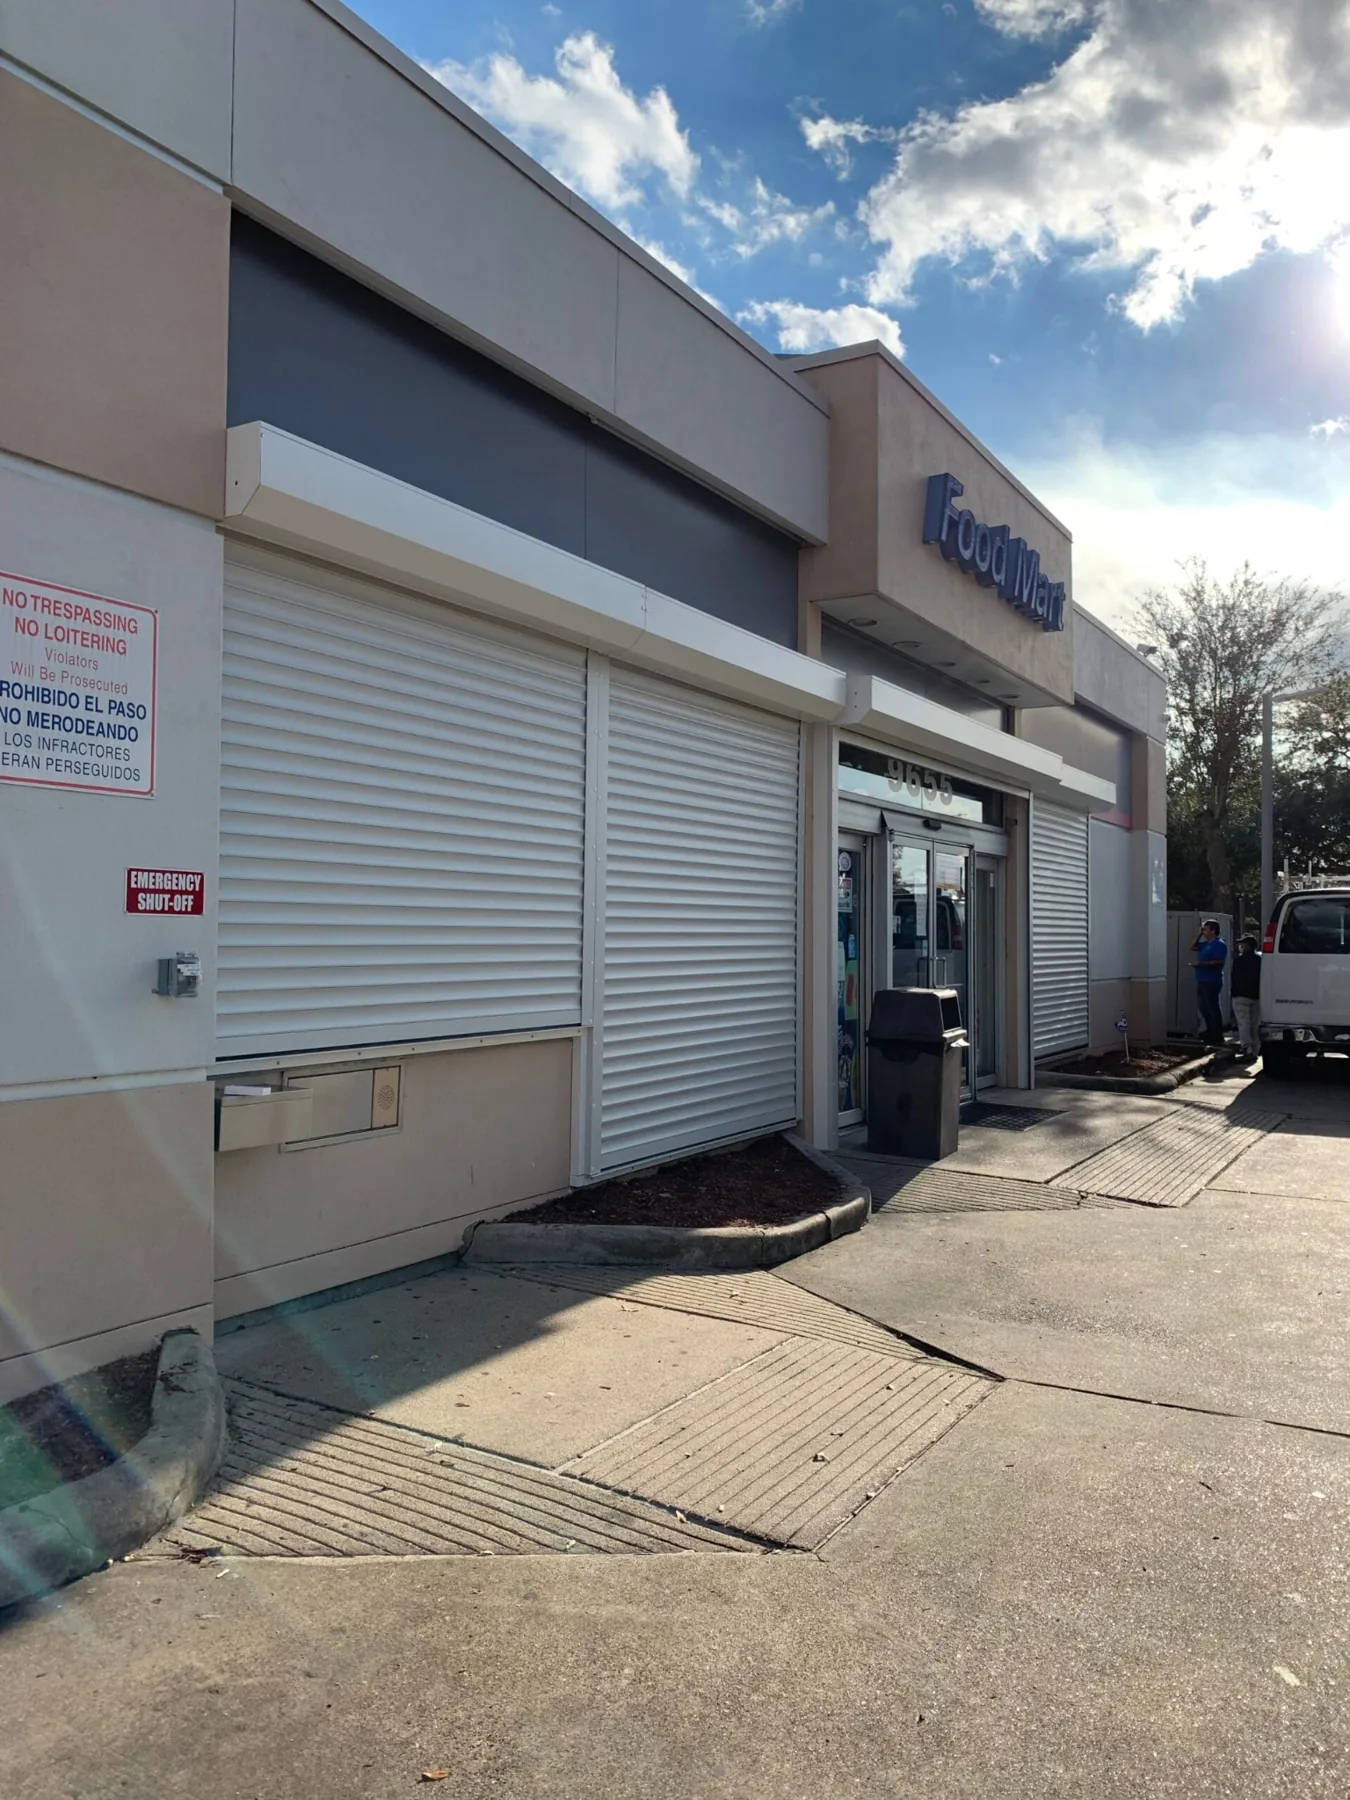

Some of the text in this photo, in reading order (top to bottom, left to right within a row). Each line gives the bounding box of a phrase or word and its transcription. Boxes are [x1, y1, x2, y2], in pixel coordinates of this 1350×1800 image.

[922, 473, 1066, 632] Food Mart
[2, 587, 138, 634] NO TRESPASSING
[14, 616, 127, 656] NO LOITERING
[44, 647, 99, 671] Violators
[11, 661, 128, 695] Will Be Prosecuted
[0, 680, 147, 720] ROHIBIDO EL PASO
[0, 706, 139, 742] NO MERODEANDO
[4, 731, 131, 762] LOS INFRACTORES
[1, 751, 141, 782] ERAN PERSEGUIDOS
[887, 757, 953, 806] 9655
[130, 870, 202, 892] EMERGENCY
[137, 892, 194, 912] SHUT-OFF
